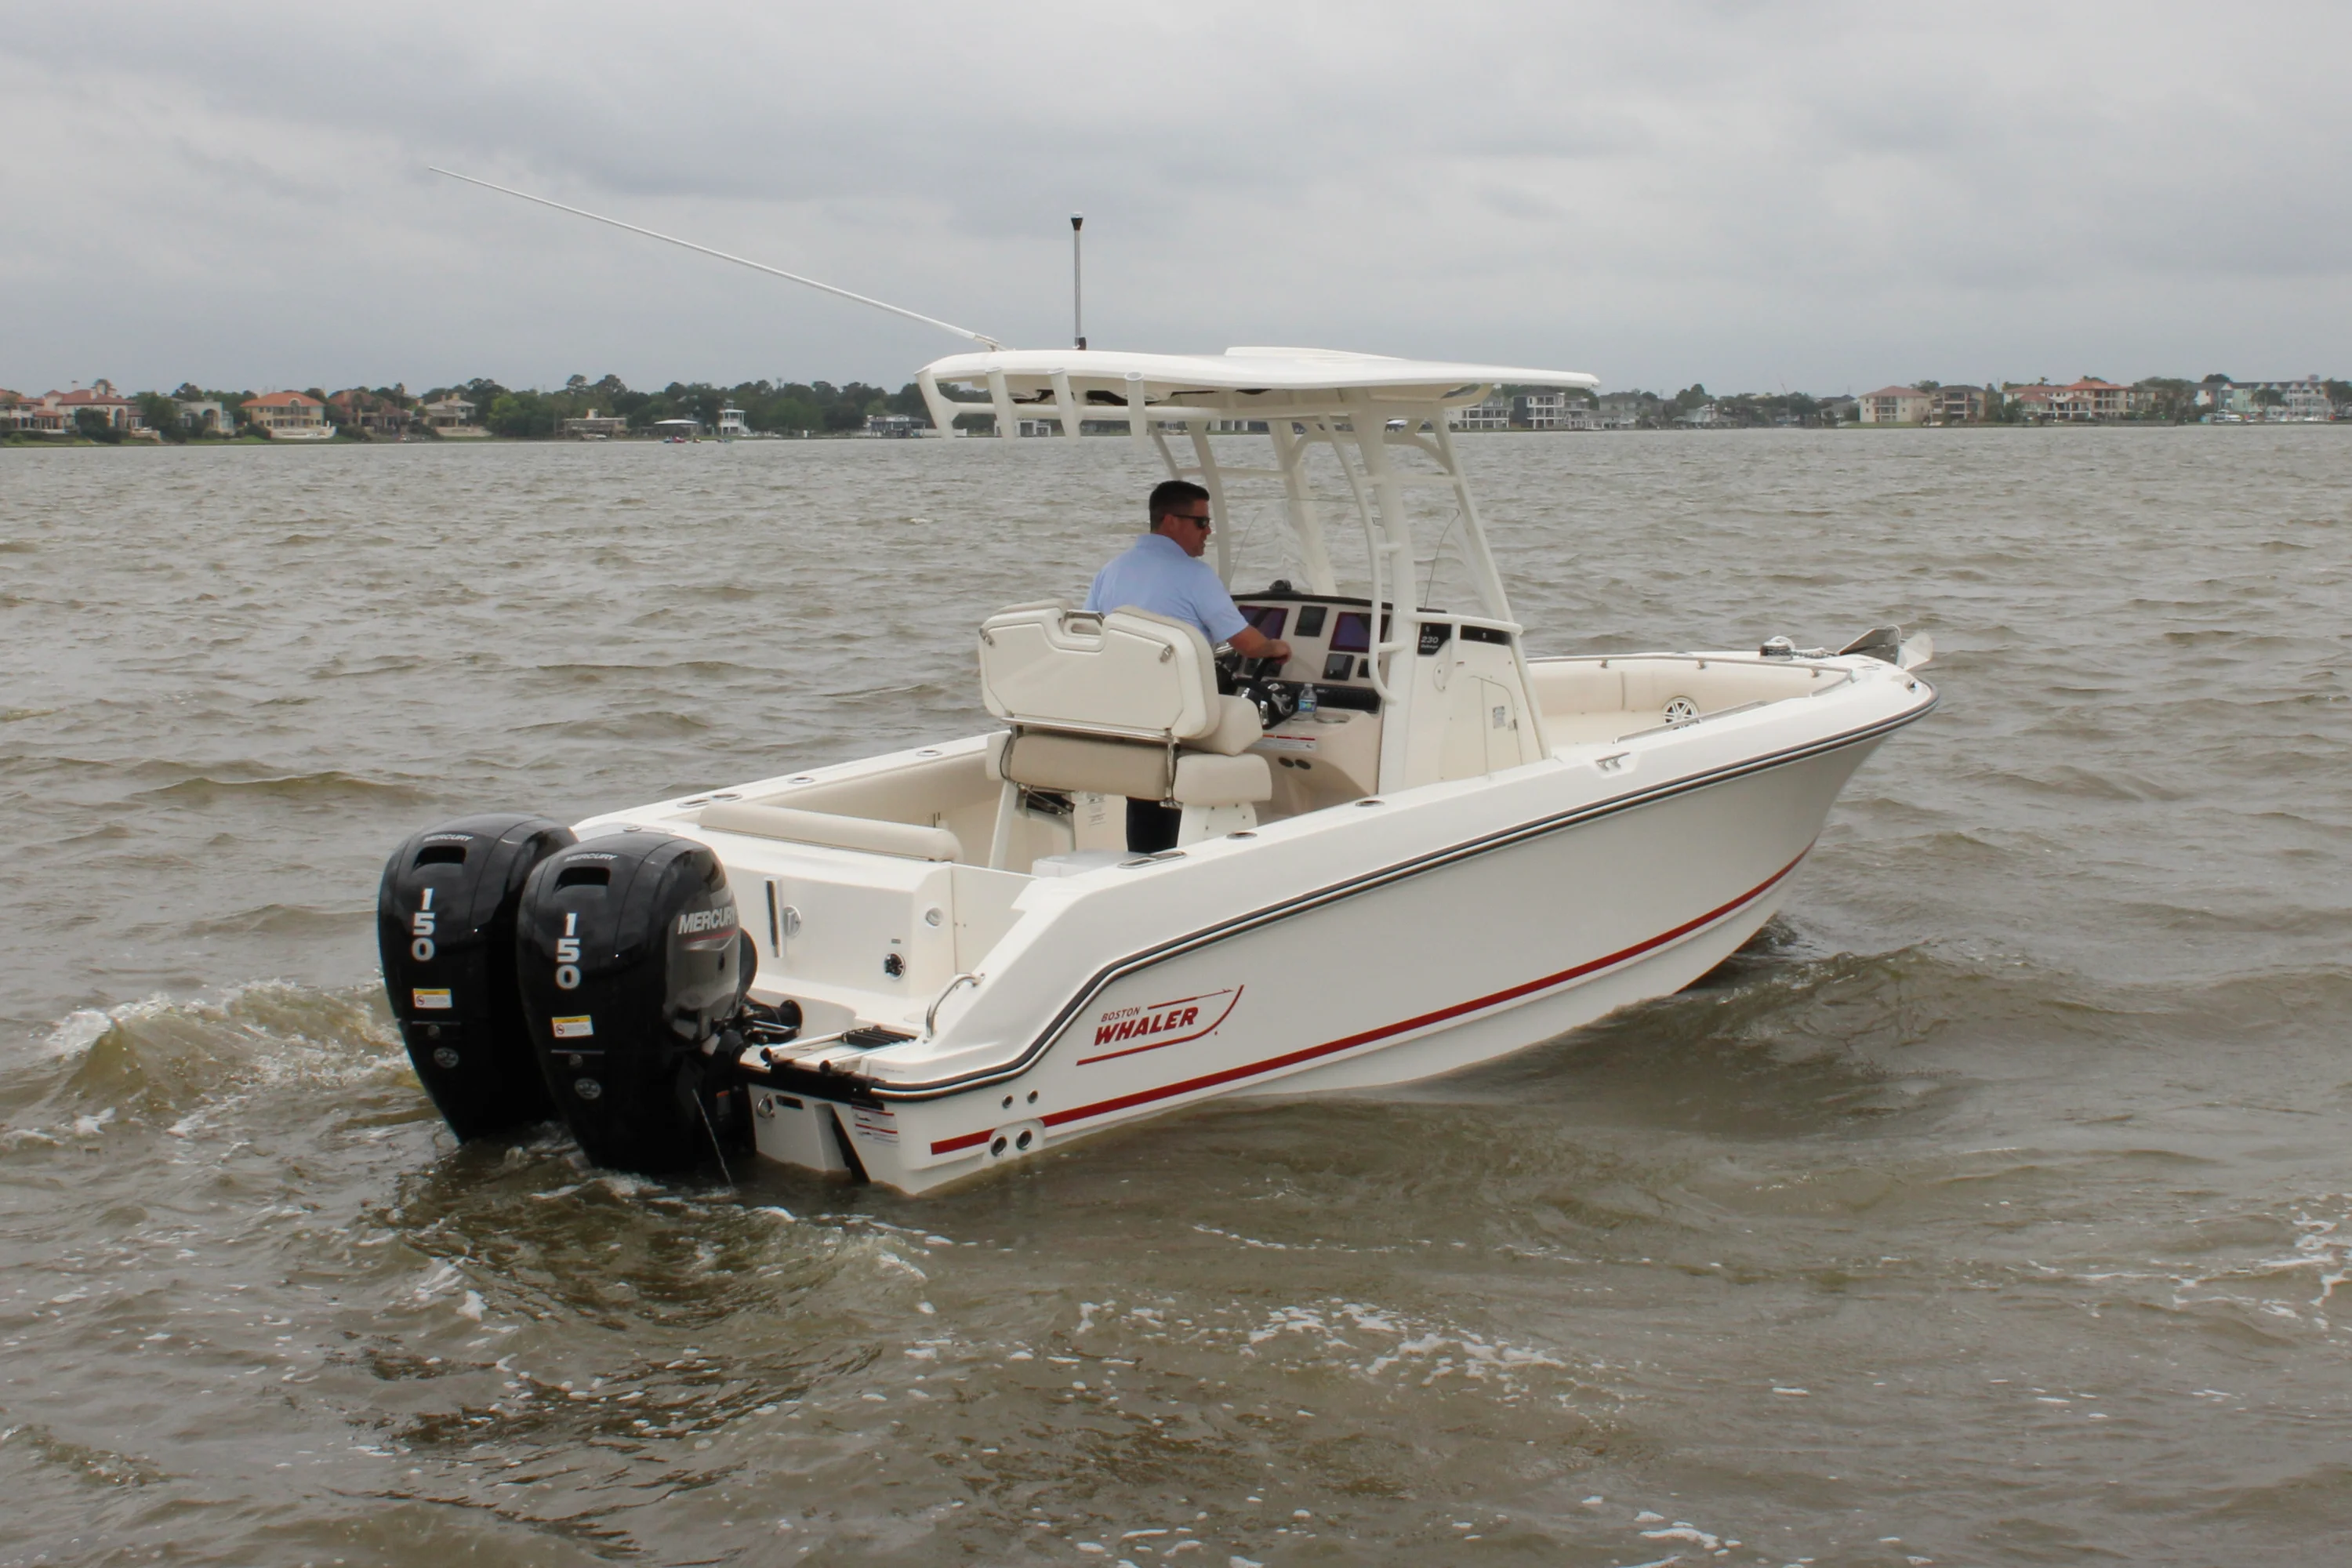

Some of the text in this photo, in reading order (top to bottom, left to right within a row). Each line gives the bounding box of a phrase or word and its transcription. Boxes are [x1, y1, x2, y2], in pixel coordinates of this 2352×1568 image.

[423, 833, 474, 842] MERCURY
[564, 853, 619, 862] MERCURY
[412, 887, 434, 962] 150
[556, 913, 582, 989] 150
[1094, 1006, 1199, 1046] WHALER
[1101, 1006, 1142, 1022] BOSTON
